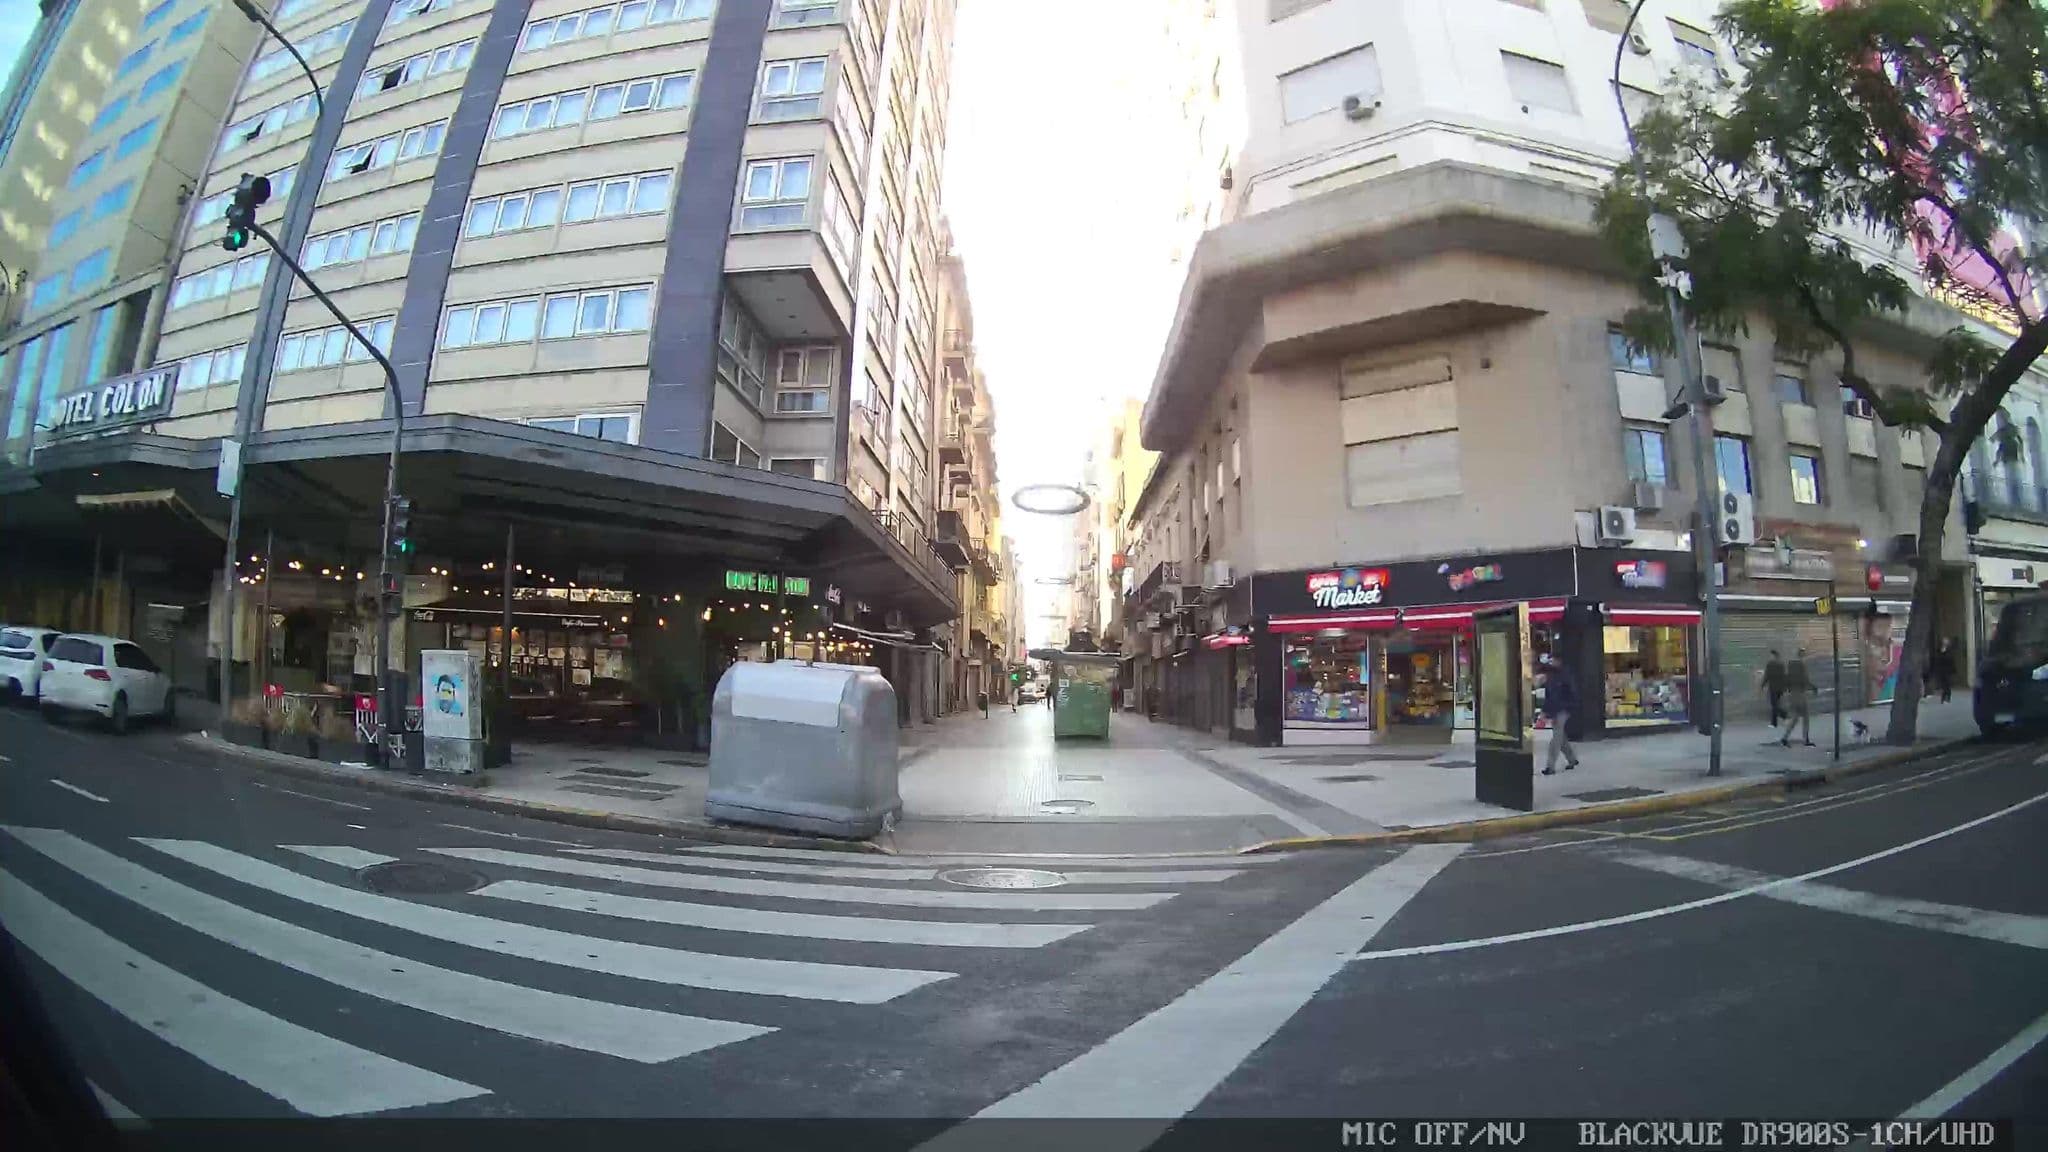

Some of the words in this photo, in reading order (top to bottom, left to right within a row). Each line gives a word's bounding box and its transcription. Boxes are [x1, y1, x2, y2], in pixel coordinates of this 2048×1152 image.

[48, 391, 94, 428] OTEL
[102, 373, 165, 418] COLON
[1313, 583, 1382, 609] Market
